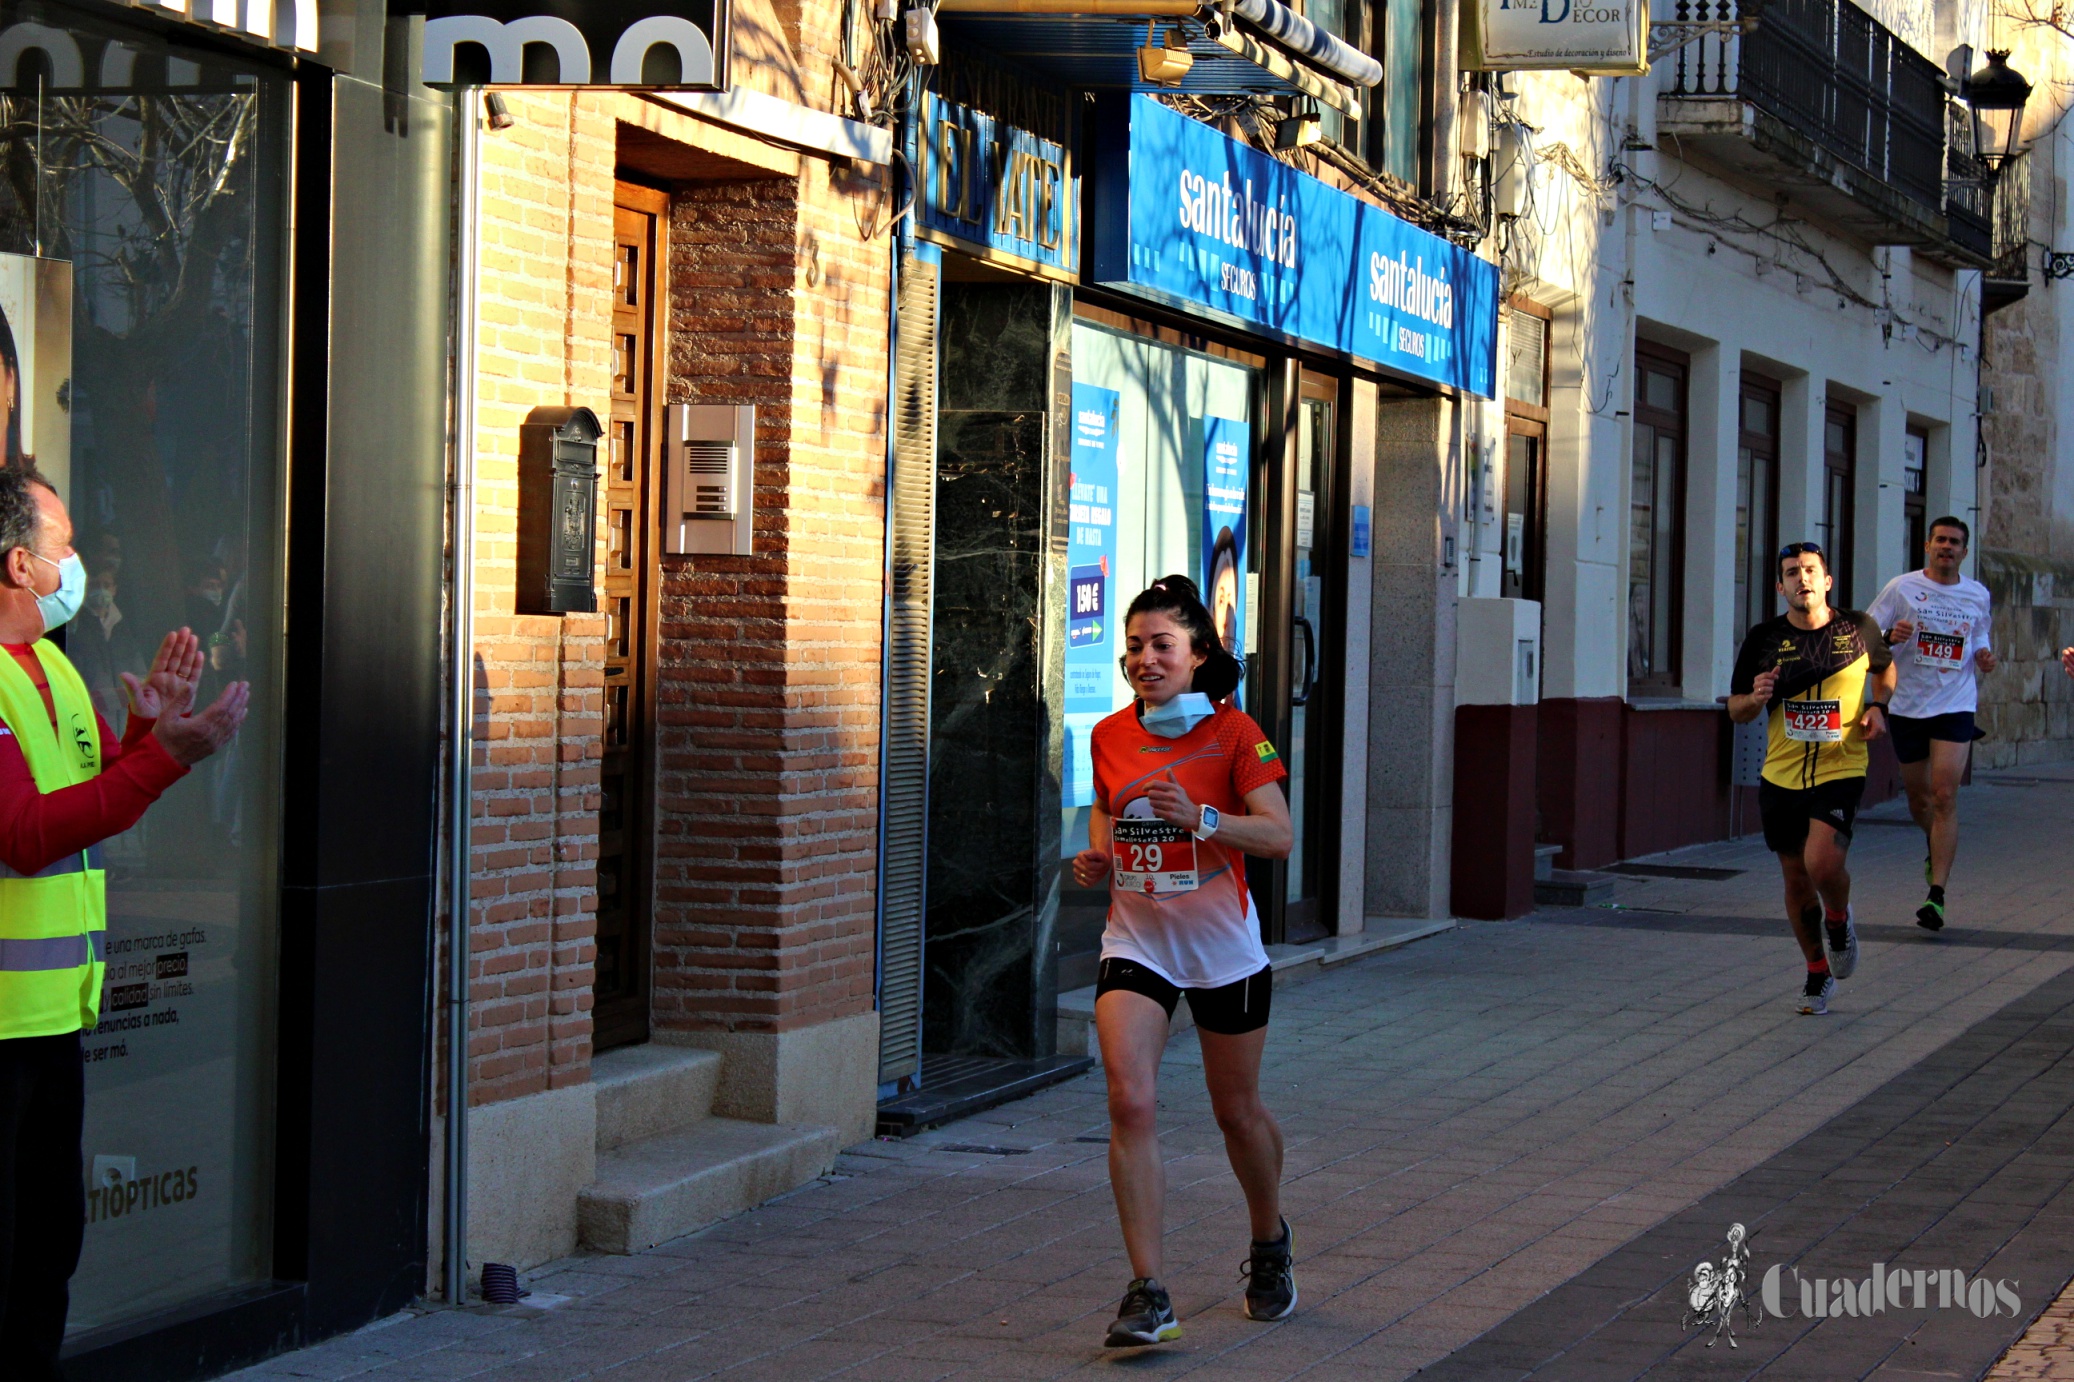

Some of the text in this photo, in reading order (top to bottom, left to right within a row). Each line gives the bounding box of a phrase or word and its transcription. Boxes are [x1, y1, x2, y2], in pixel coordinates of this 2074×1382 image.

[1528, 49, 1554, 58] Estudio
[1555, 49, 1563, 57] de
[1563, 48, 1599, 58] decoración
[937, 119, 1060, 250] EL YATE
[1179, 169, 1296, 269] santalucía
[1221, 261, 1256, 300] SEGUROS
[1370, 250, 1453, 329] santalucía
[1399, 326, 1425, 359] SEGUROS
[1927, 643, 1952, 658] 149
[1795, 714, 1828, 730] 422
[1130, 827, 1185, 836] Silvestre
[1130, 844, 1163, 872] 29
[114, 940, 131, 954] una
[134, 935, 163, 952] marca
[166, 929, 178, 948] de
[180, 927, 207, 950] gafas.
[117, 961, 127, 981] al
[128, 959, 156, 981] mejor
[112, 985, 148, 1007] calidad
[149, 984, 162, 1001] sin
[94, 1012, 142, 1035] renuncias
[143, 1014, 150, 1027] a
[152, 1006, 180, 1026] nada,
[92, 1045, 109, 1061] ser
[110, 1038, 129, 1060] mó.
